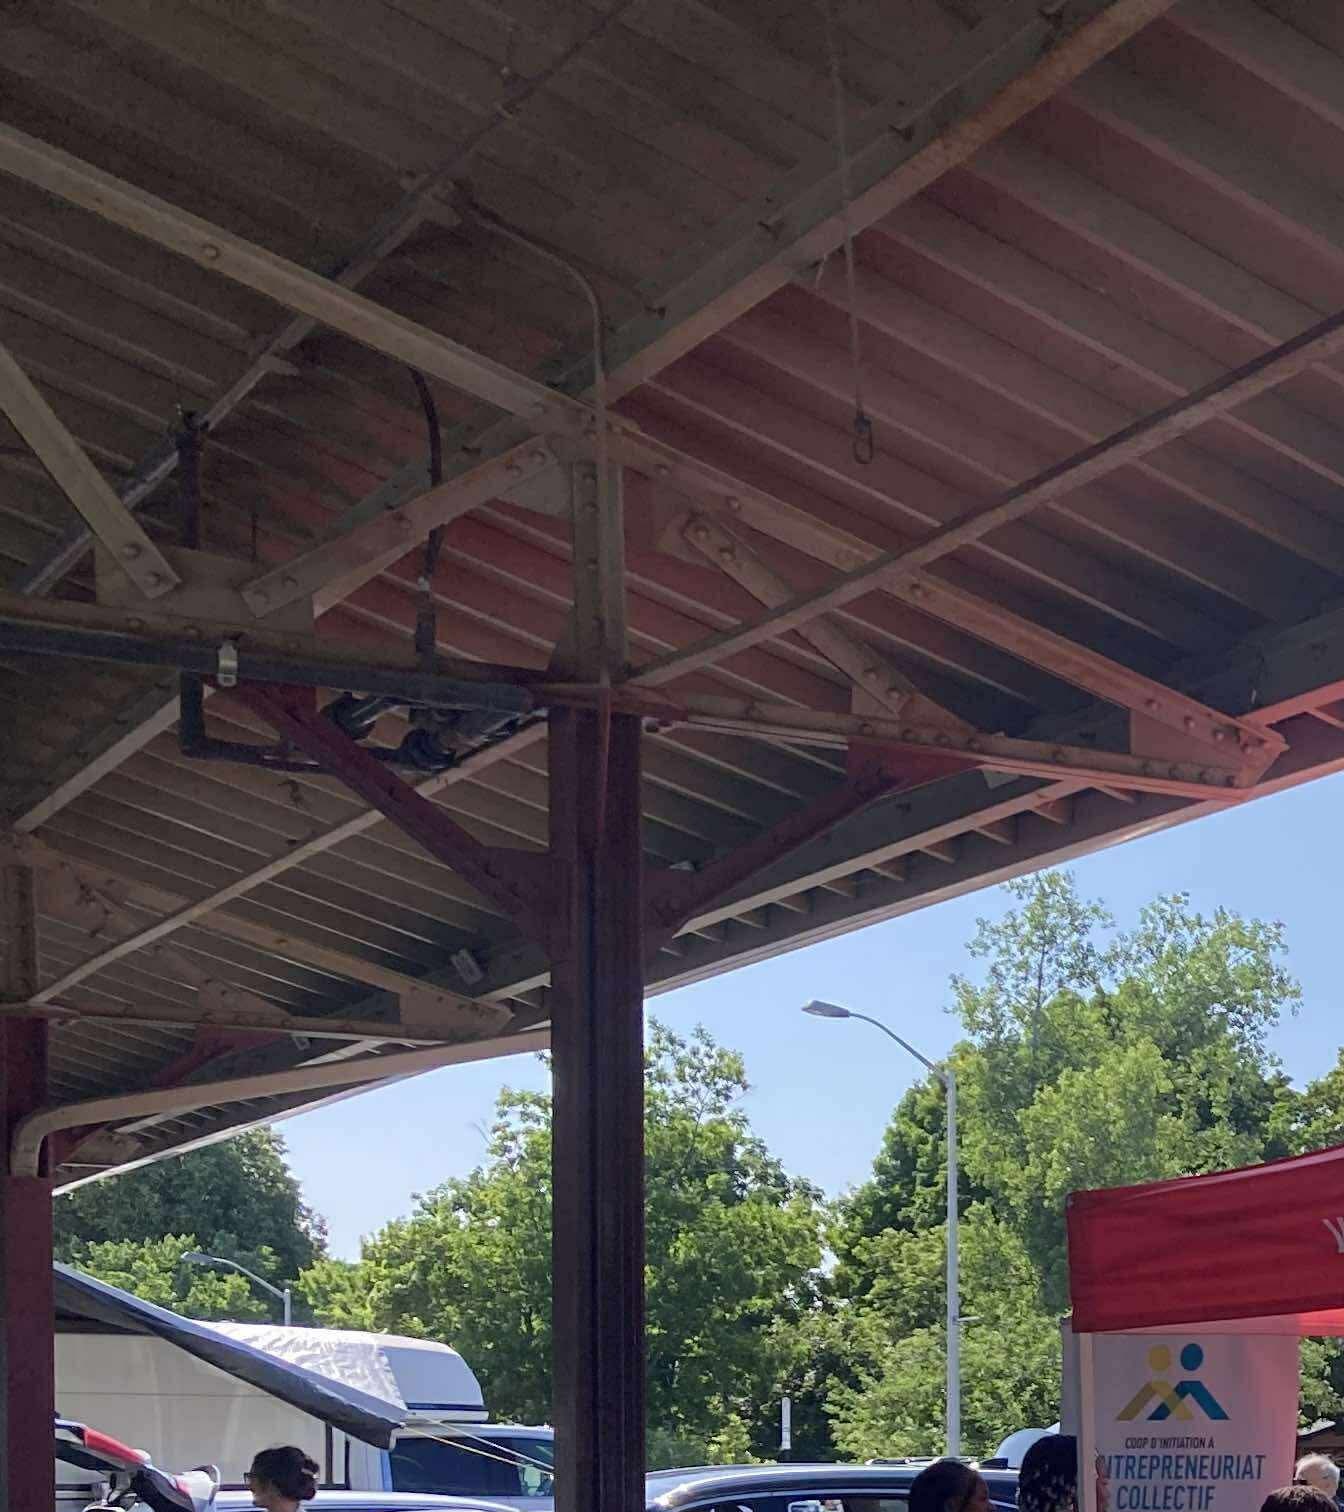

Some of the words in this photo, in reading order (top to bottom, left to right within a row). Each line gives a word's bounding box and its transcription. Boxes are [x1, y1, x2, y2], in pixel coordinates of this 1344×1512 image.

[1125, 1436, 1149, 1449] COOP
[1102, 1454, 1266, 1480] NTREPRENEURIAT
[1116, 1485, 1216, 1511] COLLECTIF
